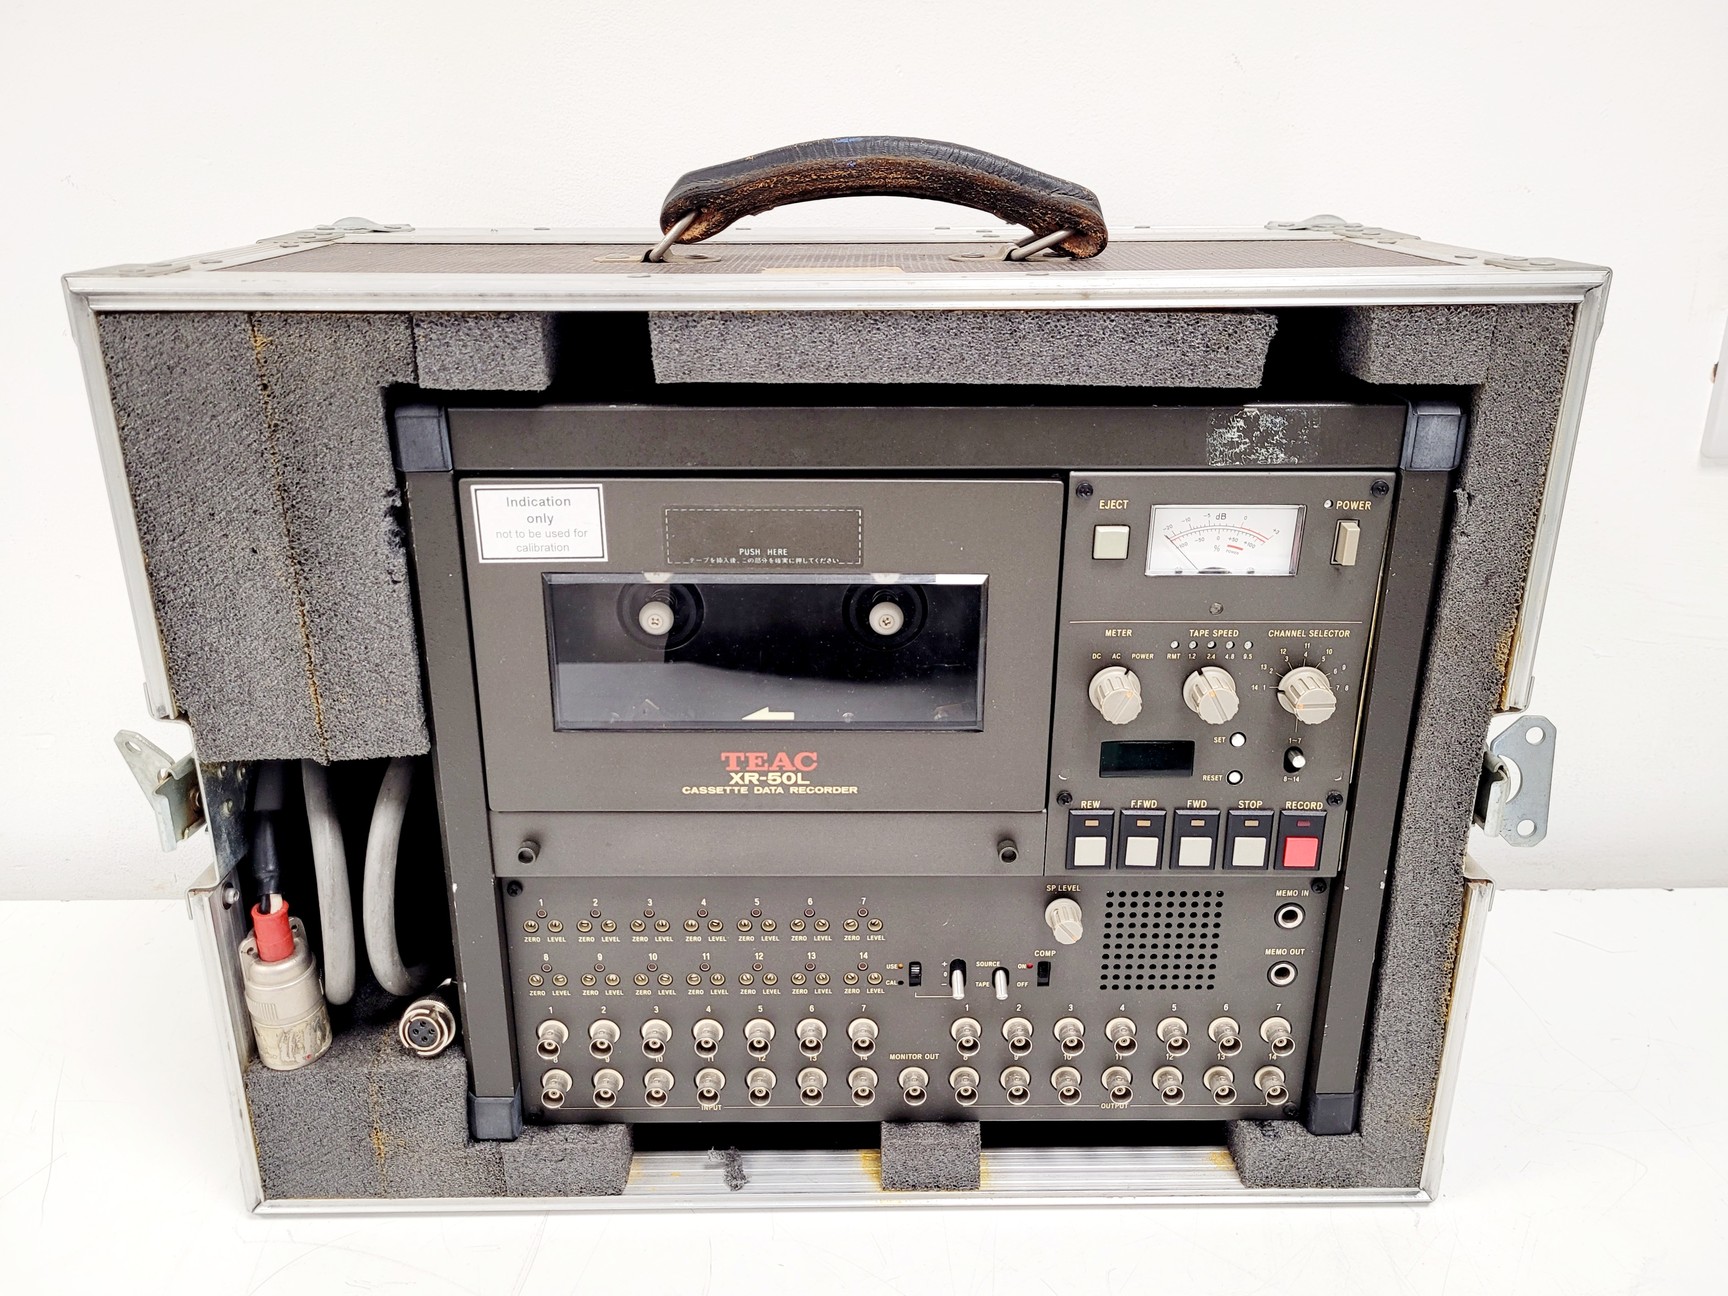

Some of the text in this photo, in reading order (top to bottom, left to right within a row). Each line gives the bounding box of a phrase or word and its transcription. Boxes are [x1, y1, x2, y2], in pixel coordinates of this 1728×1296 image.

[506, 496, 571, 507] Indication
[1099, 500, 1129, 510] EJECT
[1336, 500, 1372, 510] POWER
[527, 513, 554, 526] only
[1215, 512, 1227, 520] dB
[496, 528, 588, 539] not to be used for
[516, 543, 570, 552] calibration
[739, 548, 788, 556] PUSH HERE
[1105, 629, 1133, 637] METER
[1189, 629, 1239, 637] TAPE SPEED
[1268, 630, 1351, 638] CHANNEL SELECTOR
[720, 751, 818, 771] TEAC
[729, 772, 810, 785] XR-50L
[1202, 774, 1223, 782] RESET
[682, 786, 858, 794] CASSETTE DATA RECORDER
[1080, 800, 1101, 809] REW
[1130, 800, 1158, 808] F.FWD
[1187, 800, 1208, 808] FWD
[1238, 800, 1263, 809] STOP
[1285, 801, 1324, 810] RECORD
[1046, 884, 1081, 892] SP LEVEL
[1275, 889, 1310, 897] MEMO IN
[538, 898, 543, 906] 1
[592, 898, 599, 906] 2
[647, 898, 653, 906] 3
[701, 898, 707, 906] 4
[754, 898, 760, 906] 5
[807, 897, 813, 905] 6
[861, 897, 866, 905] 7
[702, 952, 710, 960] 11
[755, 952, 764, 960] 12
[807, 952, 817, 960] 13
[859, 952, 868, 960] 14
[1265, 948, 1305, 956] MEMO OUT
[543, 953, 549, 961] 8
[597, 953, 603, 961] 9
[648, 953, 658, 961] 10
[548, 1006, 553, 1014] 1
[601, 1006, 607, 1014] 2
[653, 1006, 659, 1014] 3
[706, 1005, 712, 1013] 4
[758, 1005, 763, 1013] 5
[809, 1005, 815, 1013] 6
[861, 1004, 867, 1012] 7
[965, 1004, 969, 1012] 1
[1016, 1004, 1022, 1012] 2
[1068, 1004, 1074, 1012] 3
[1119, 1003, 1125, 1011] 4
[1171, 1003, 1177, 1011] 5
[1223, 1003, 1229, 1011] 6
[1276, 1003, 1282, 1011] 7
